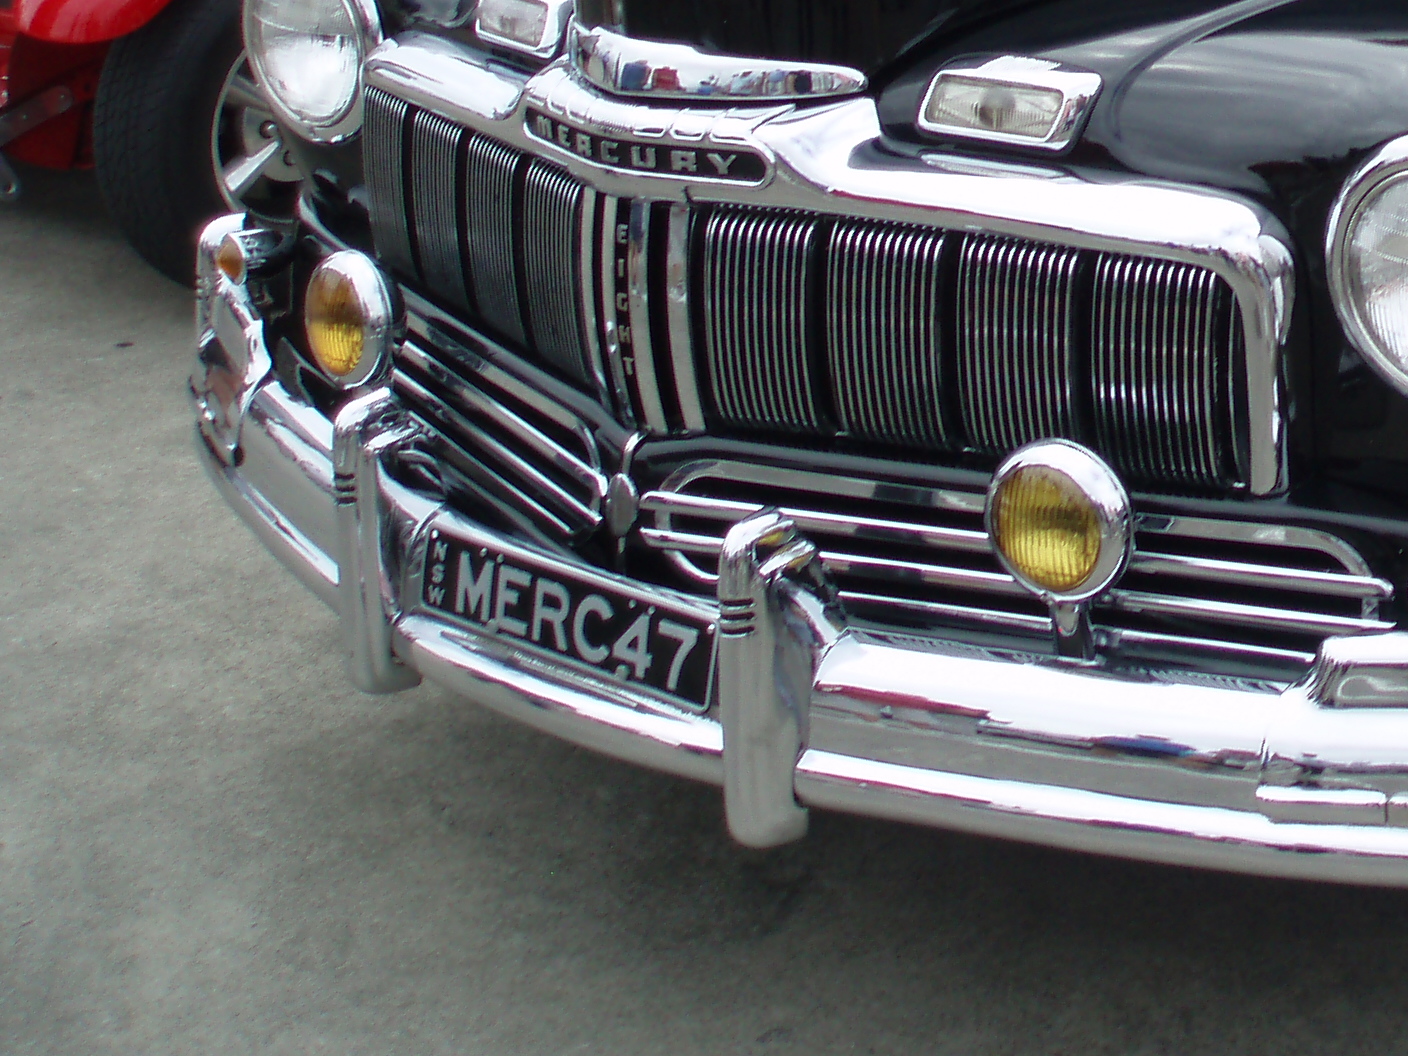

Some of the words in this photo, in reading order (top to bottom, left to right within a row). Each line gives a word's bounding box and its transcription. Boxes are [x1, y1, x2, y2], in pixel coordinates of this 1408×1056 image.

[536, 114, 737, 176] MERCURY
[615, 223, 637, 377] EIGHT
[427, 540, 449, 607] NSW
